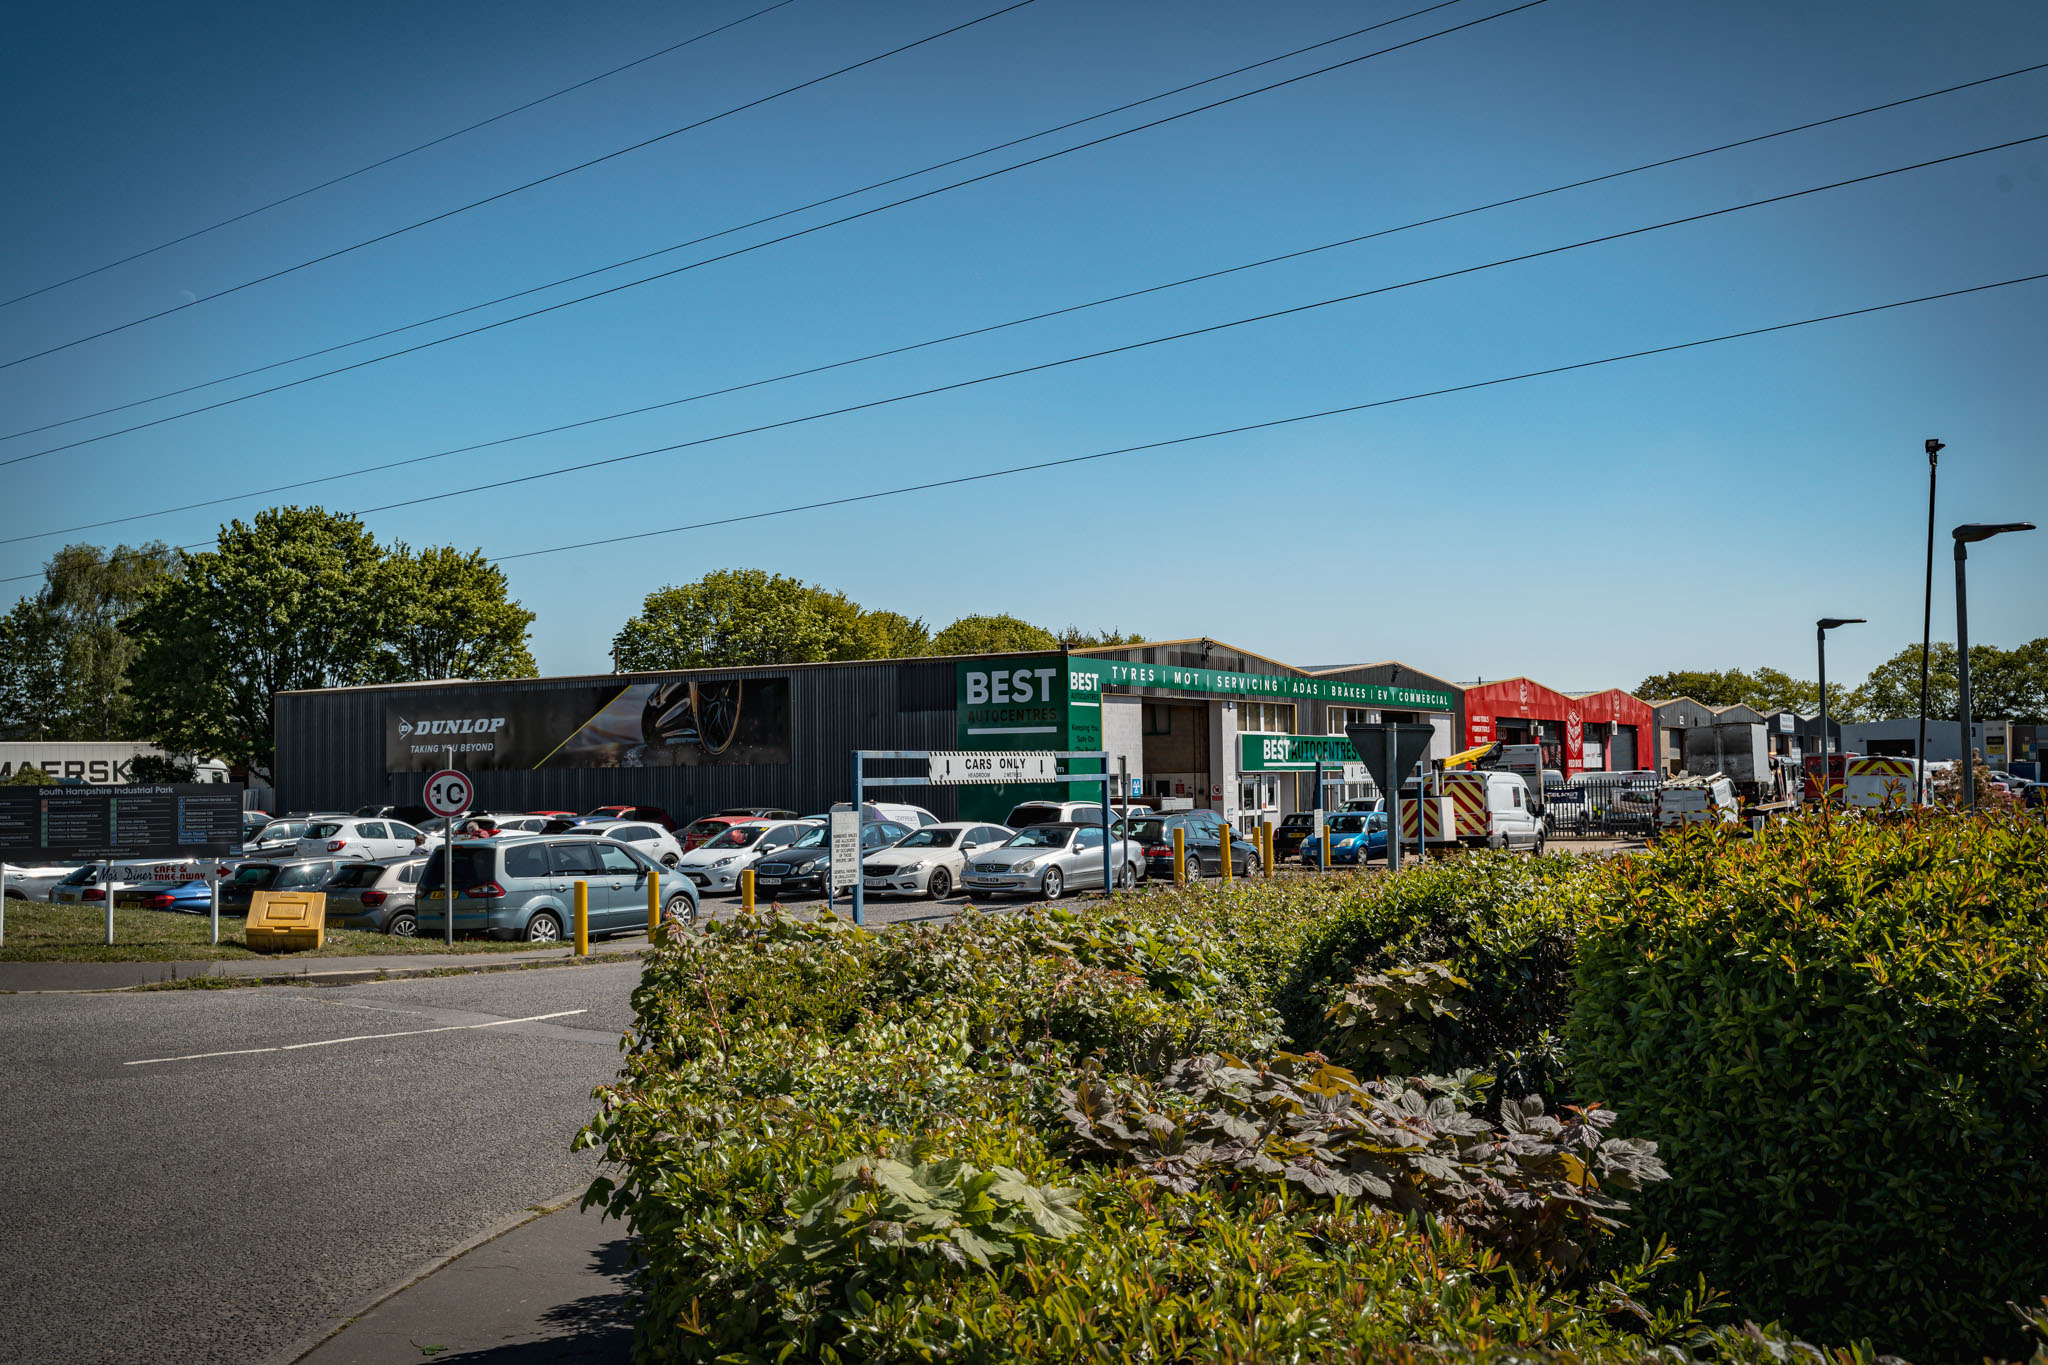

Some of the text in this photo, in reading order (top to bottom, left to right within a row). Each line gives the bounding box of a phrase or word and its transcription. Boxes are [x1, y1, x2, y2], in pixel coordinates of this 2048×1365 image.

[967, 668, 1056, 704] BEST
[1070, 672, 1100, 692] BEST
[1112, 666, 1448, 706] TYRES MOT SERVICING ADAS BRAKES EV COMMERCIAL
[1070, 692, 1099, 701] AUTOCENTRES
[968, 708, 1056, 724] AUTOCENTRES
[414, 718, 505, 736] DUNLOP
[1072, 724, 1090, 733] Keeping
[410, 743, 494, 753] TAKING YOU BEYOND
[1263, 740, 1356, 760] BEST AUTOCENTRES
[965, 758, 1026, 770] CARS ONLY
[66, 788, 112, 796] Hampshire
[432, 783, 464, 805] 10
[99, 867, 152, 881] Mo's Diner
